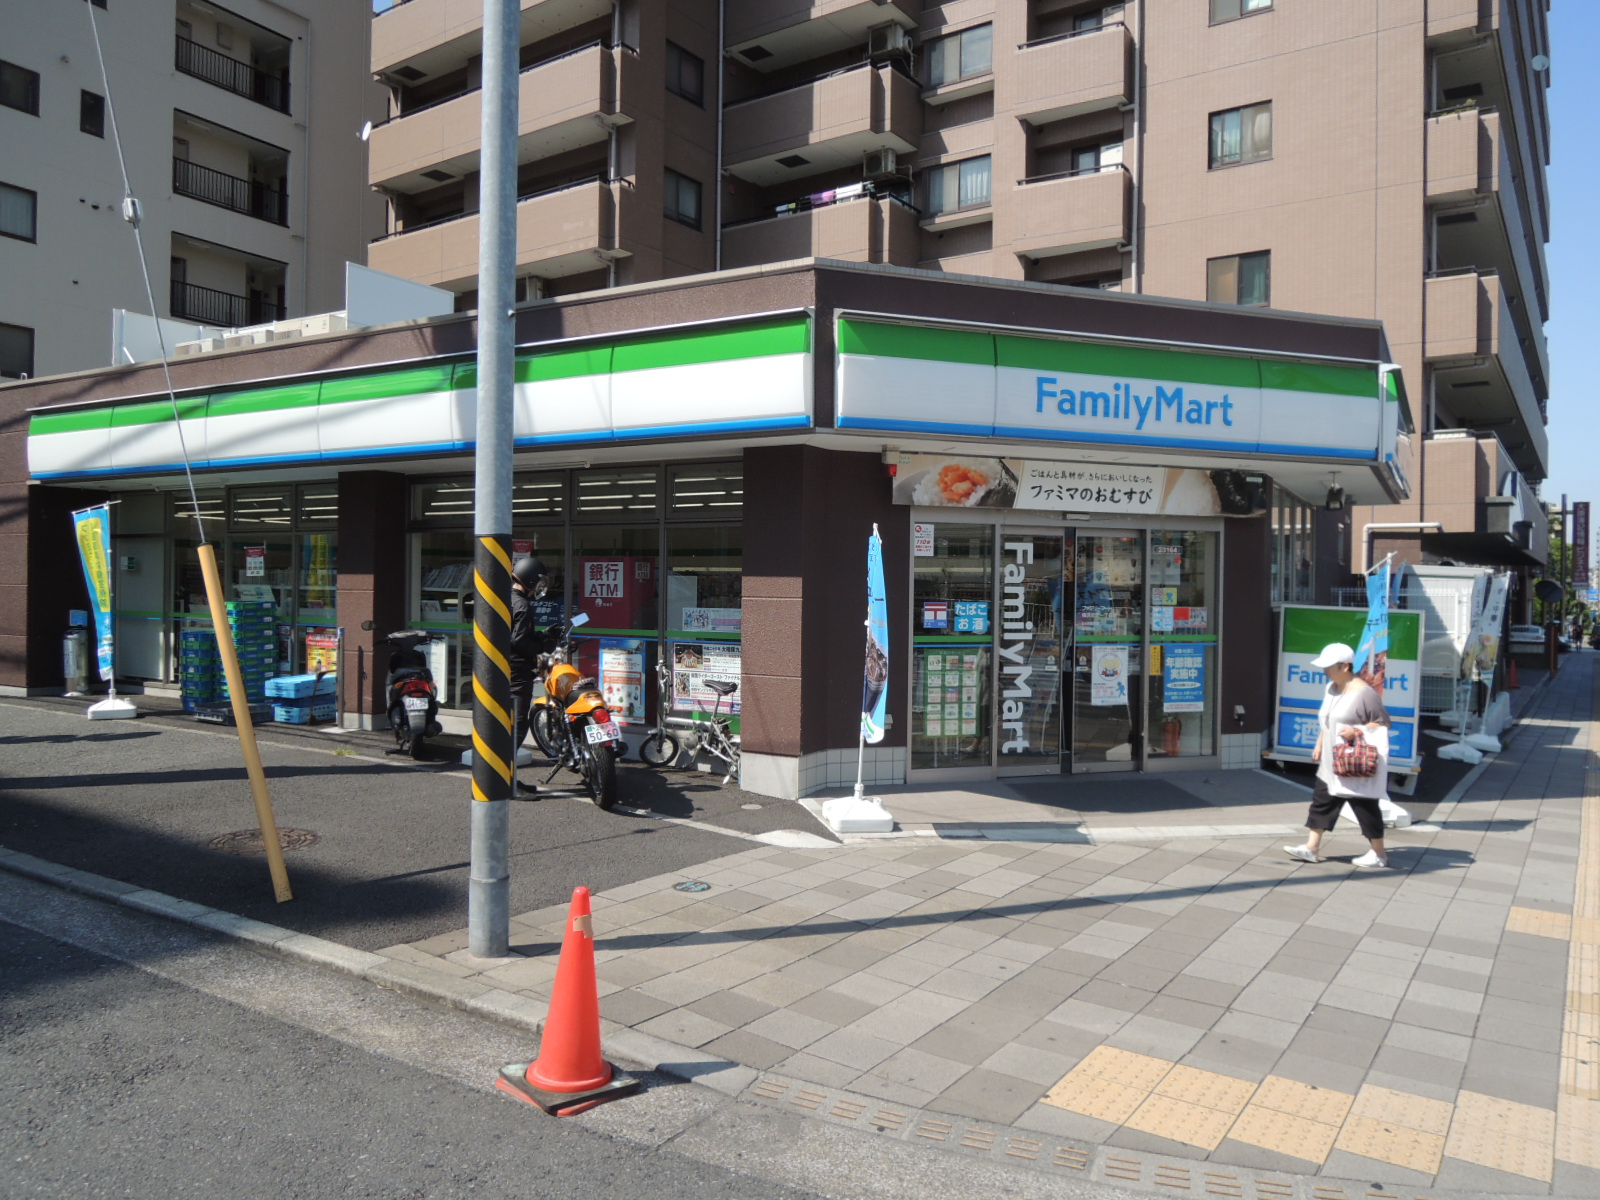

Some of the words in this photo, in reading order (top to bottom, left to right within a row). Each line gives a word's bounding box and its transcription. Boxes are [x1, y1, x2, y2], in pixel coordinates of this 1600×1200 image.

[1036, 376, 1233, 431] FamilyMart
[1030, 484, 1153, 505] ファミマのおむすび
[589, 563, 620, 581] 銀行
[588, 583, 619, 596] ATM
[955, 603, 987, 615] たばこ
[958, 617, 985, 630] お酒
[999, 542, 1034, 754] FamilyMart
[1165, 656, 1203, 668] 年齢確認
[1170, 668, 1198, 680] 実施中
[588, 728, 619, 742] 50-60
